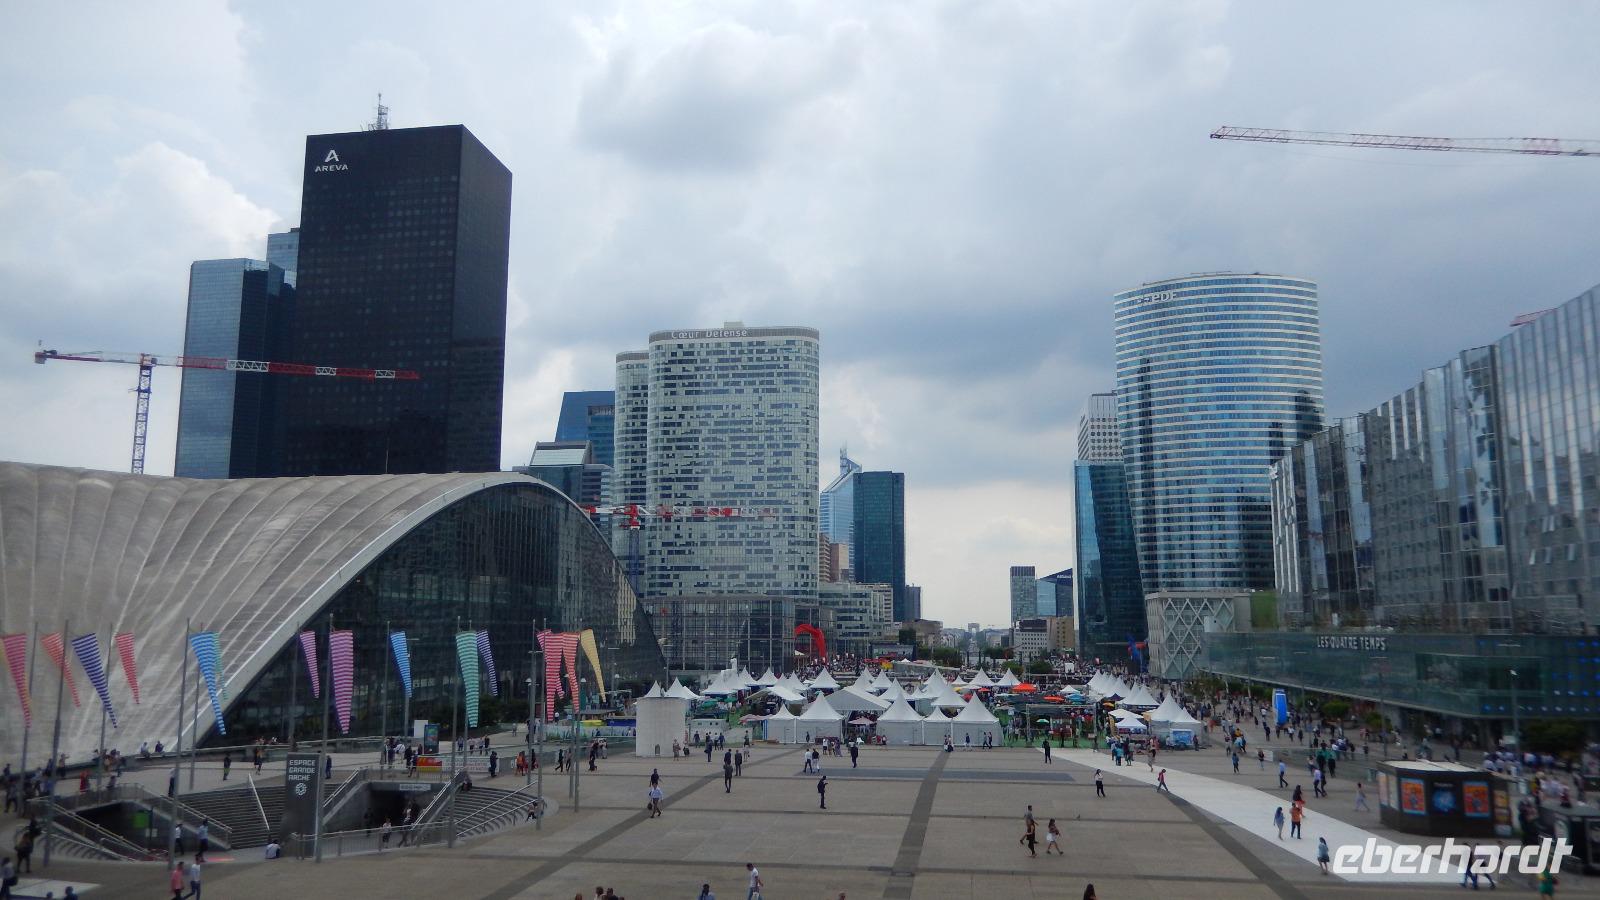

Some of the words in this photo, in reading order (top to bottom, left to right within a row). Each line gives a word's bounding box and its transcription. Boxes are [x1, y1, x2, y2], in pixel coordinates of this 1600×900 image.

[314, 164, 349, 173] AREVA
[1316, 636, 1329, 648] LES
[1330, 636, 1358, 650] QUATRE
[1359, 636, 1386, 651] TEMPS
[289, 759, 316, 767] ESPACE
[288, 766, 316, 774] GRANDE
[288, 774, 312, 782] ARCHE
